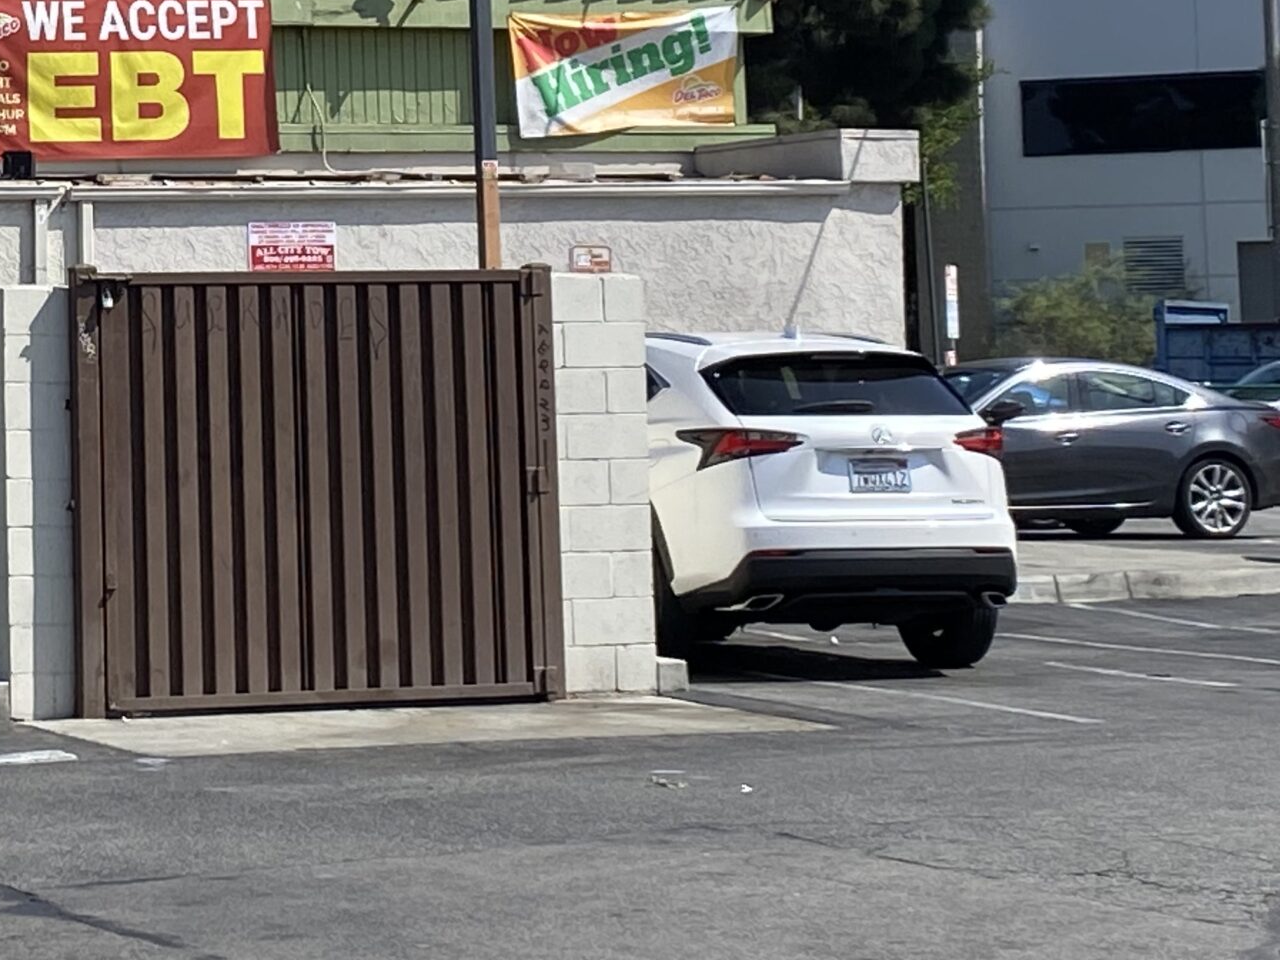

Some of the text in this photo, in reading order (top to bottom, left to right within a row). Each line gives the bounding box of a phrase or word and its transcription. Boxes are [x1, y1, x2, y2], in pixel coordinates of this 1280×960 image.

[21, 0, 265, 41] WE ACCEPT
[27, 50, 266, 143] EBT
[531, 14, 712, 118] Hiring!
[256, 246, 331, 257] ALL CITY TOW
